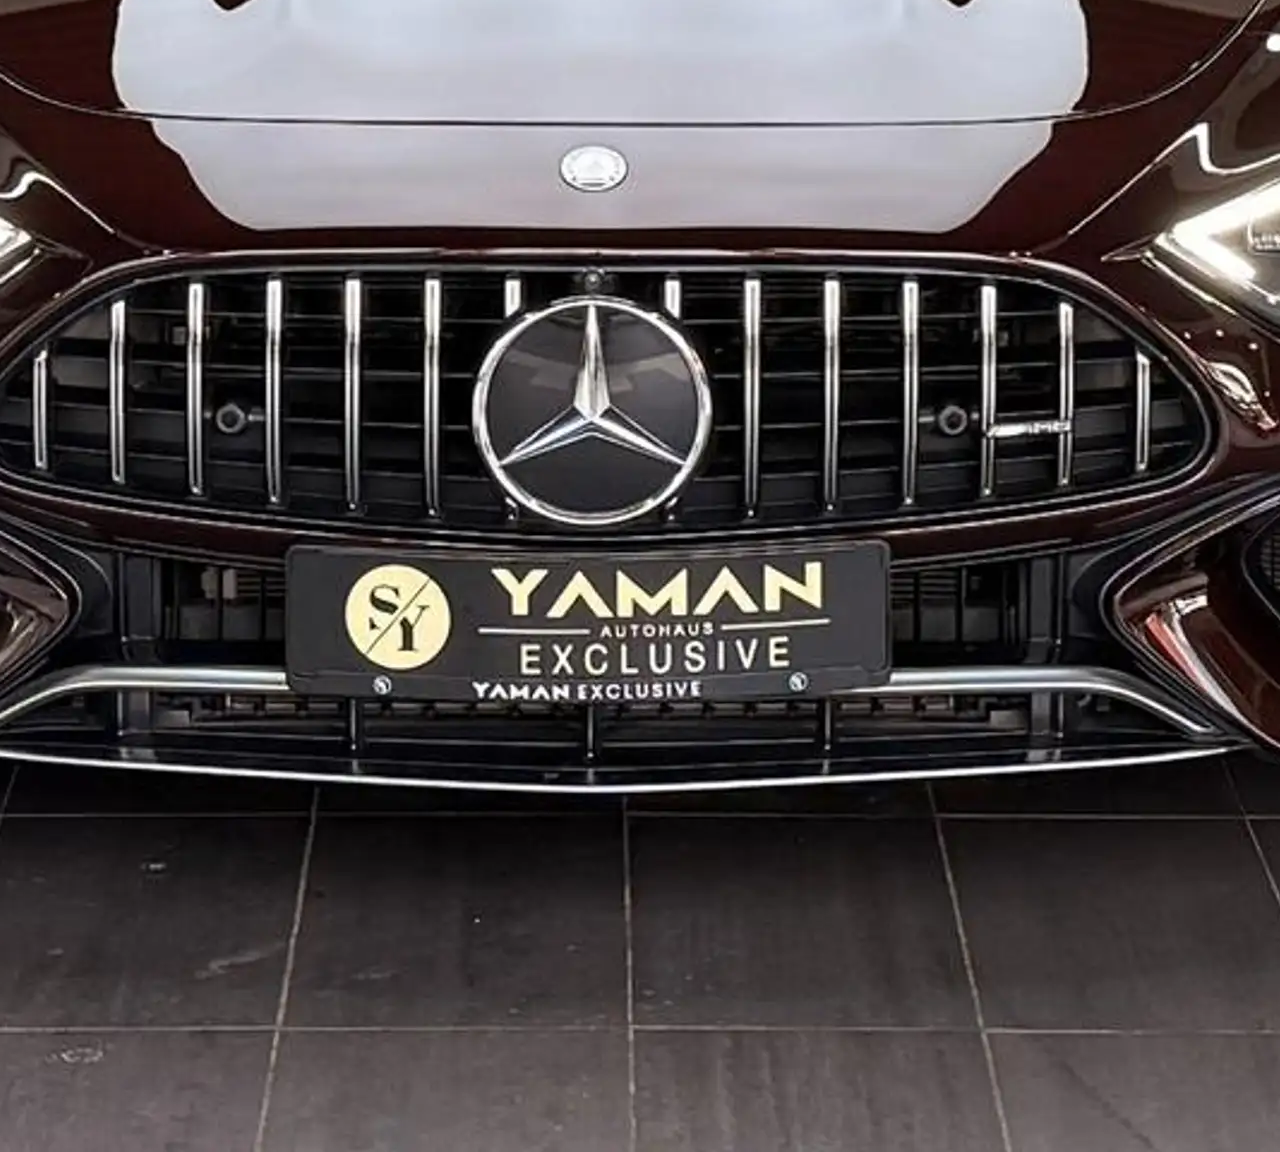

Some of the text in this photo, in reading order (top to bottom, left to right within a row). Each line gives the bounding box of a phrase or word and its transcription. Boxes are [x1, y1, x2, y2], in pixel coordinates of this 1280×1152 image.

[490, 560, 823, 619] YAMAN
[599, 621, 714, 639] AUTOHAUS
[519, 635, 791, 676] EXCLUSIVE
[471, 679, 703, 700] YAMAN EXCLUSIVE
